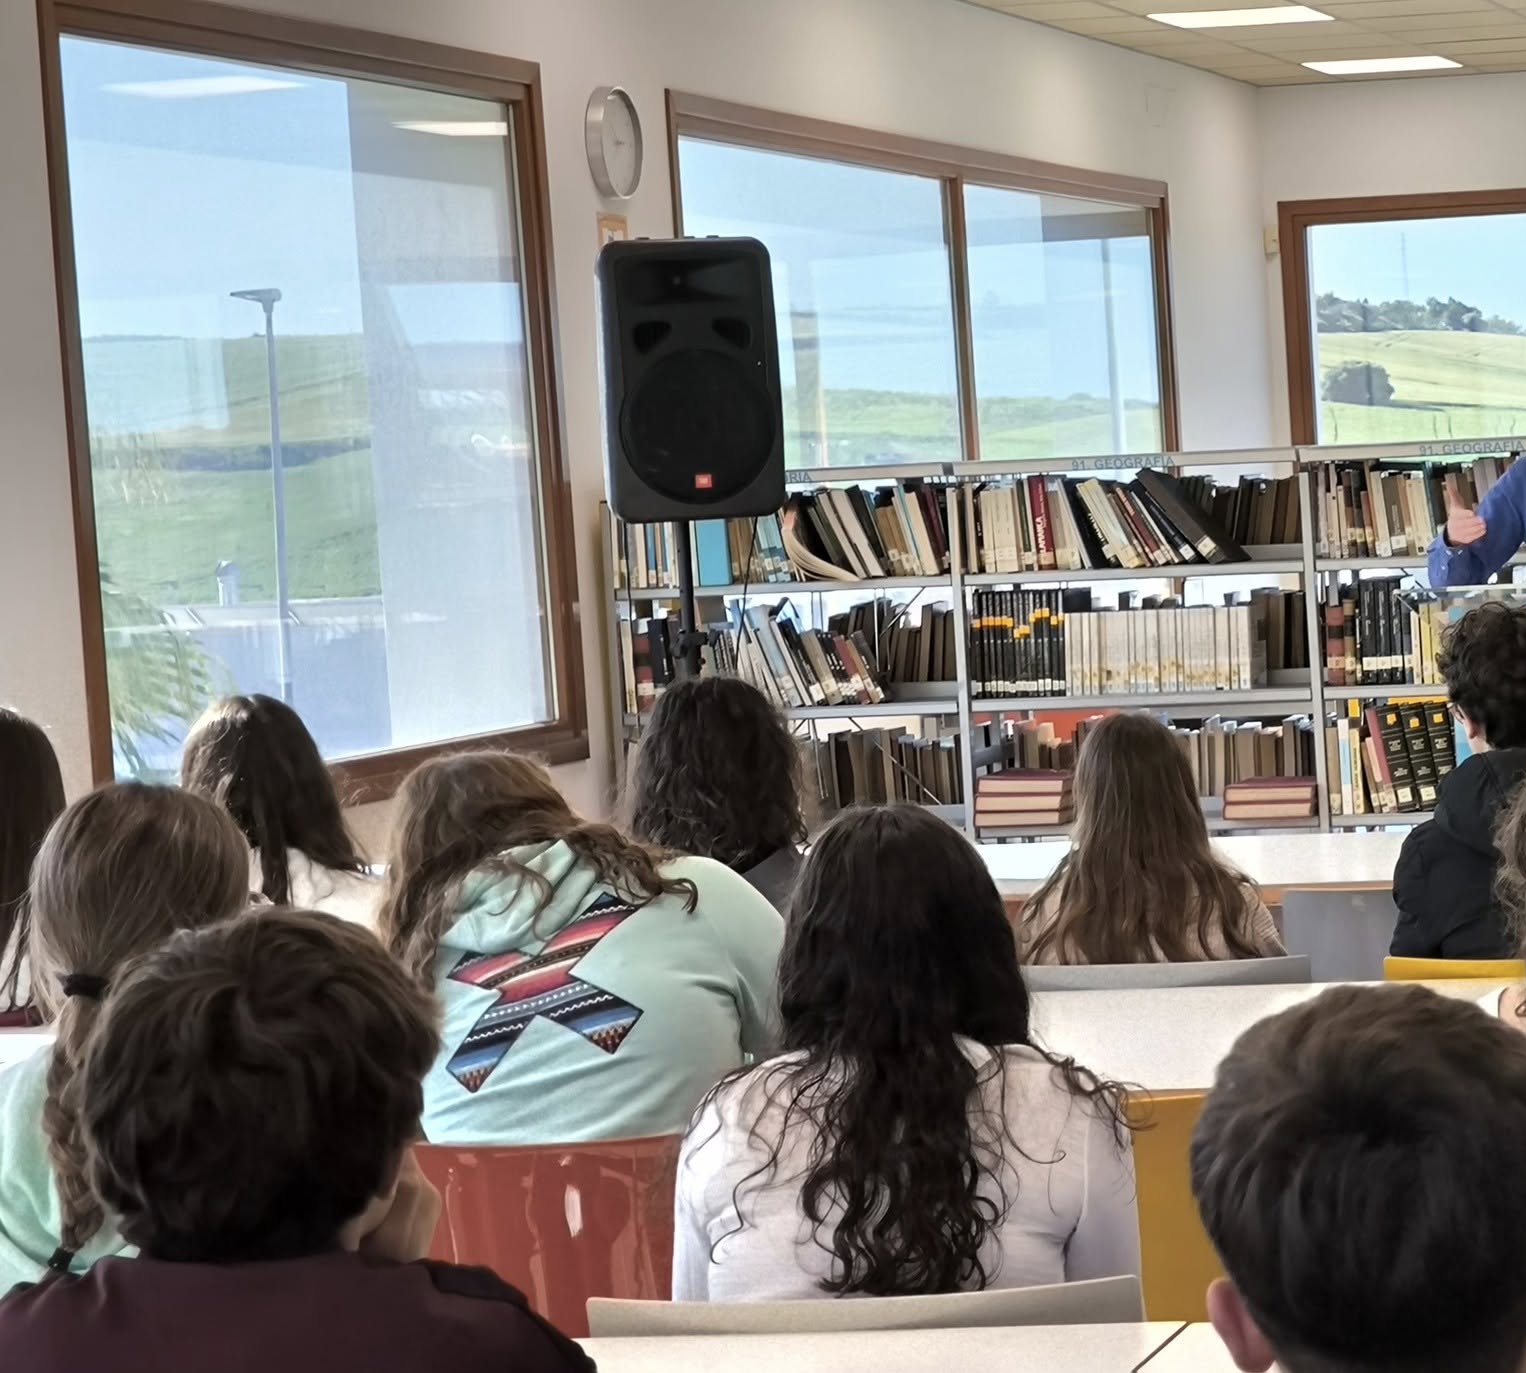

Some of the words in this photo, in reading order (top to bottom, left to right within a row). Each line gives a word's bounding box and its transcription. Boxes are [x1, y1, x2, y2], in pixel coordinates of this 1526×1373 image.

[1419, 445, 1439, 456] 91.
[1442, 439, 1525, 454] GEOGRAFIA
[1094, 456, 1175, 470] GEOGRAFIA
